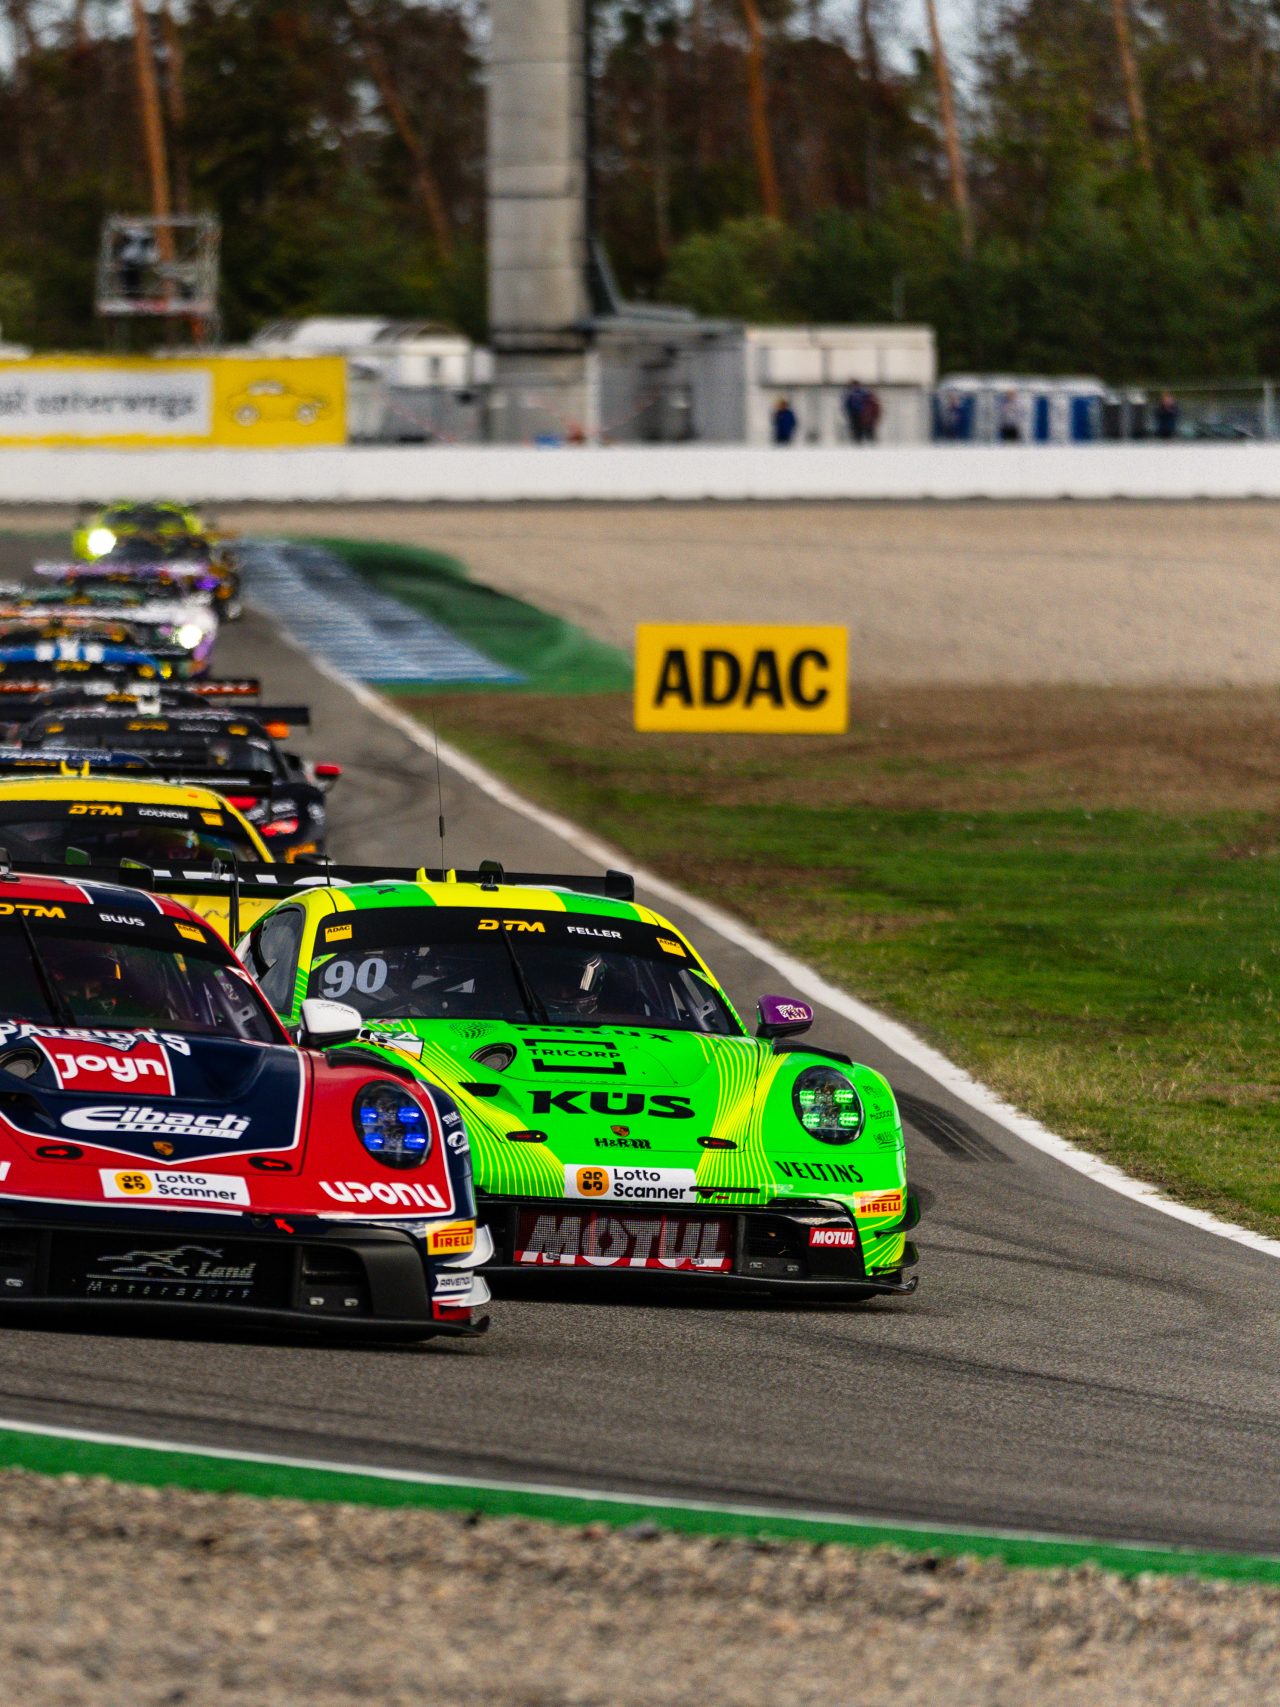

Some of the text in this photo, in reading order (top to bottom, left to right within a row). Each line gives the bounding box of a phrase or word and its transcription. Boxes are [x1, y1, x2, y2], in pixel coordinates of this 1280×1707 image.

[654, 649, 830, 711] ADAC
[69, 804, 123, 817] DTM
[138, 808, 190, 821] GOUNON
[99, 913, 146, 927] BUUS
[477, 919, 546, 933] DTM
[326, 925, 350, 934] ADAC
[566, 926, 623, 940] FELLER
[323, 957, 388, 998] 90
[527, 1048, 621, 1059] TRICORP
[61, 1105, 251, 1134] Eibach
[594, 1137, 632, 1150] H&R
[155, 1172, 207, 1186] Lotto
[614, 1168, 661, 1182] Lotto
[773, 1161, 865, 1184] VELTINS
[158, 1184, 238, 1201] Scanner
[613, 1183, 687, 1200] Scanner
[860, 1194, 901, 1214] PIRELLI
[433, 1227, 474, 1249] PIRELLI
[520, 1214, 727, 1268] MOTUL
[812, 1230, 856, 1245] MOTUL
[194, 1262, 257, 1279] Land
